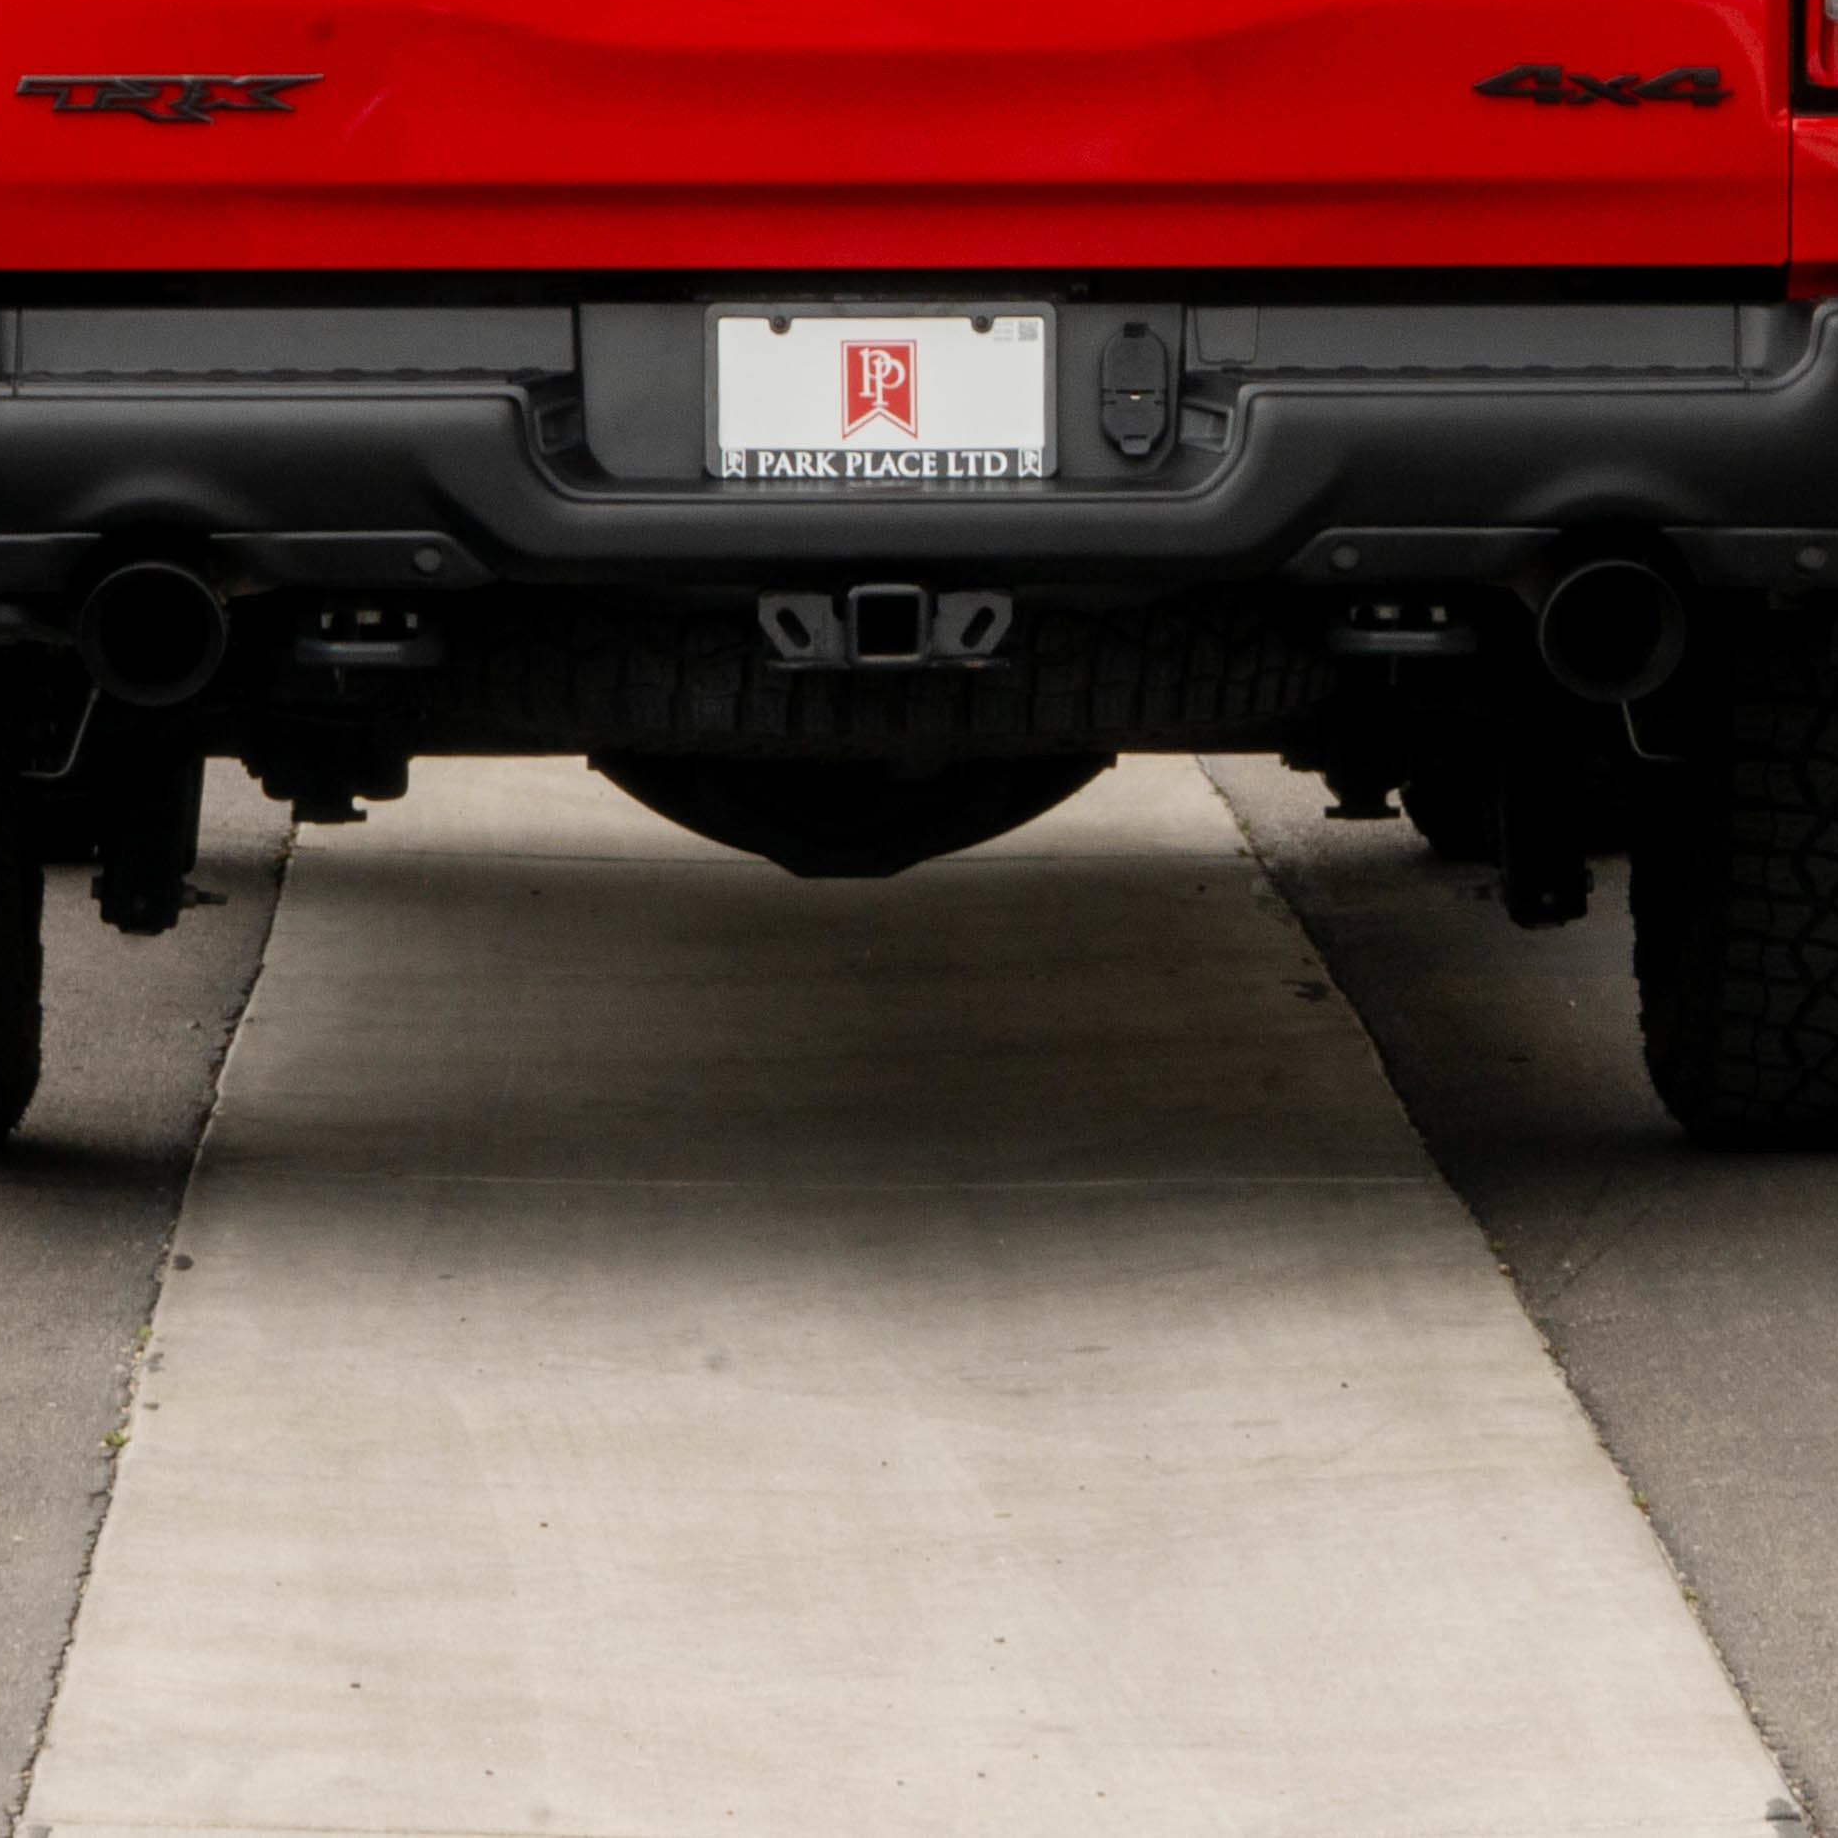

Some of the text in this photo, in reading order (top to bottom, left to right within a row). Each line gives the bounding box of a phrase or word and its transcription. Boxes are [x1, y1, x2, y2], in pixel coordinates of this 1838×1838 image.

[15, 74, 324, 124] TRX
[1471, 64, 1735, 107] 4x4
[757, 450, 1008, 478] PARK PLACE LTD
